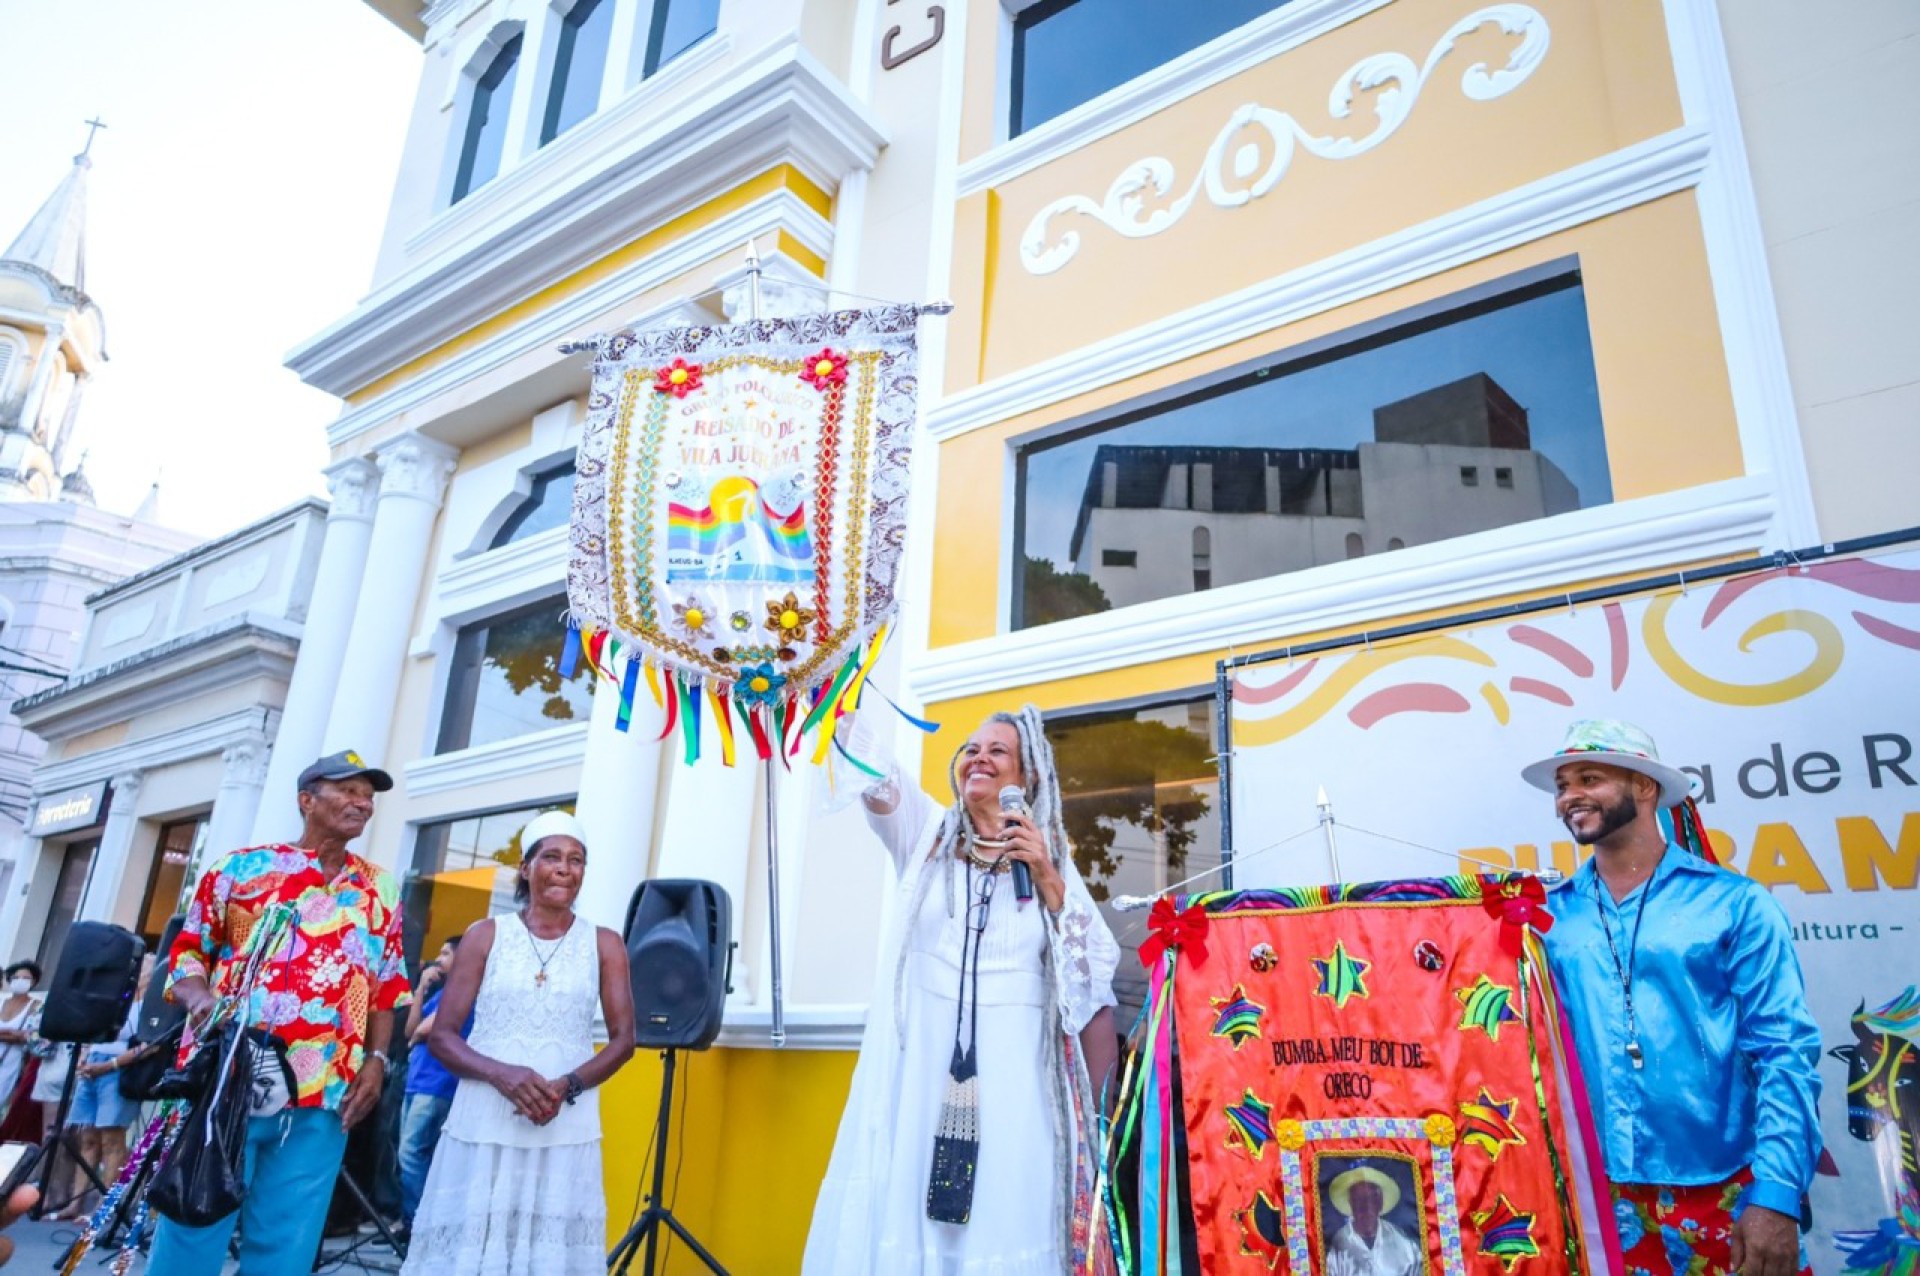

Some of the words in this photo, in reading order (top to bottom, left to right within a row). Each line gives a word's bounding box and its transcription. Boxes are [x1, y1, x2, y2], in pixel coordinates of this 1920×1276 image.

[778, 417, 796, 440] DE
[681, 447, 721, 467] VILA
[1738, 742, 1841, 799] de
[1272, 1038, 1328, 1066] BUMBA
[1331, 1036, 1363, 1063] MEU
[1370, 1039, 1396, 1067] BOI
[1401, 1043, 1424, 1068] DE
[1323, 1071, 1372, 1100] ORECO
